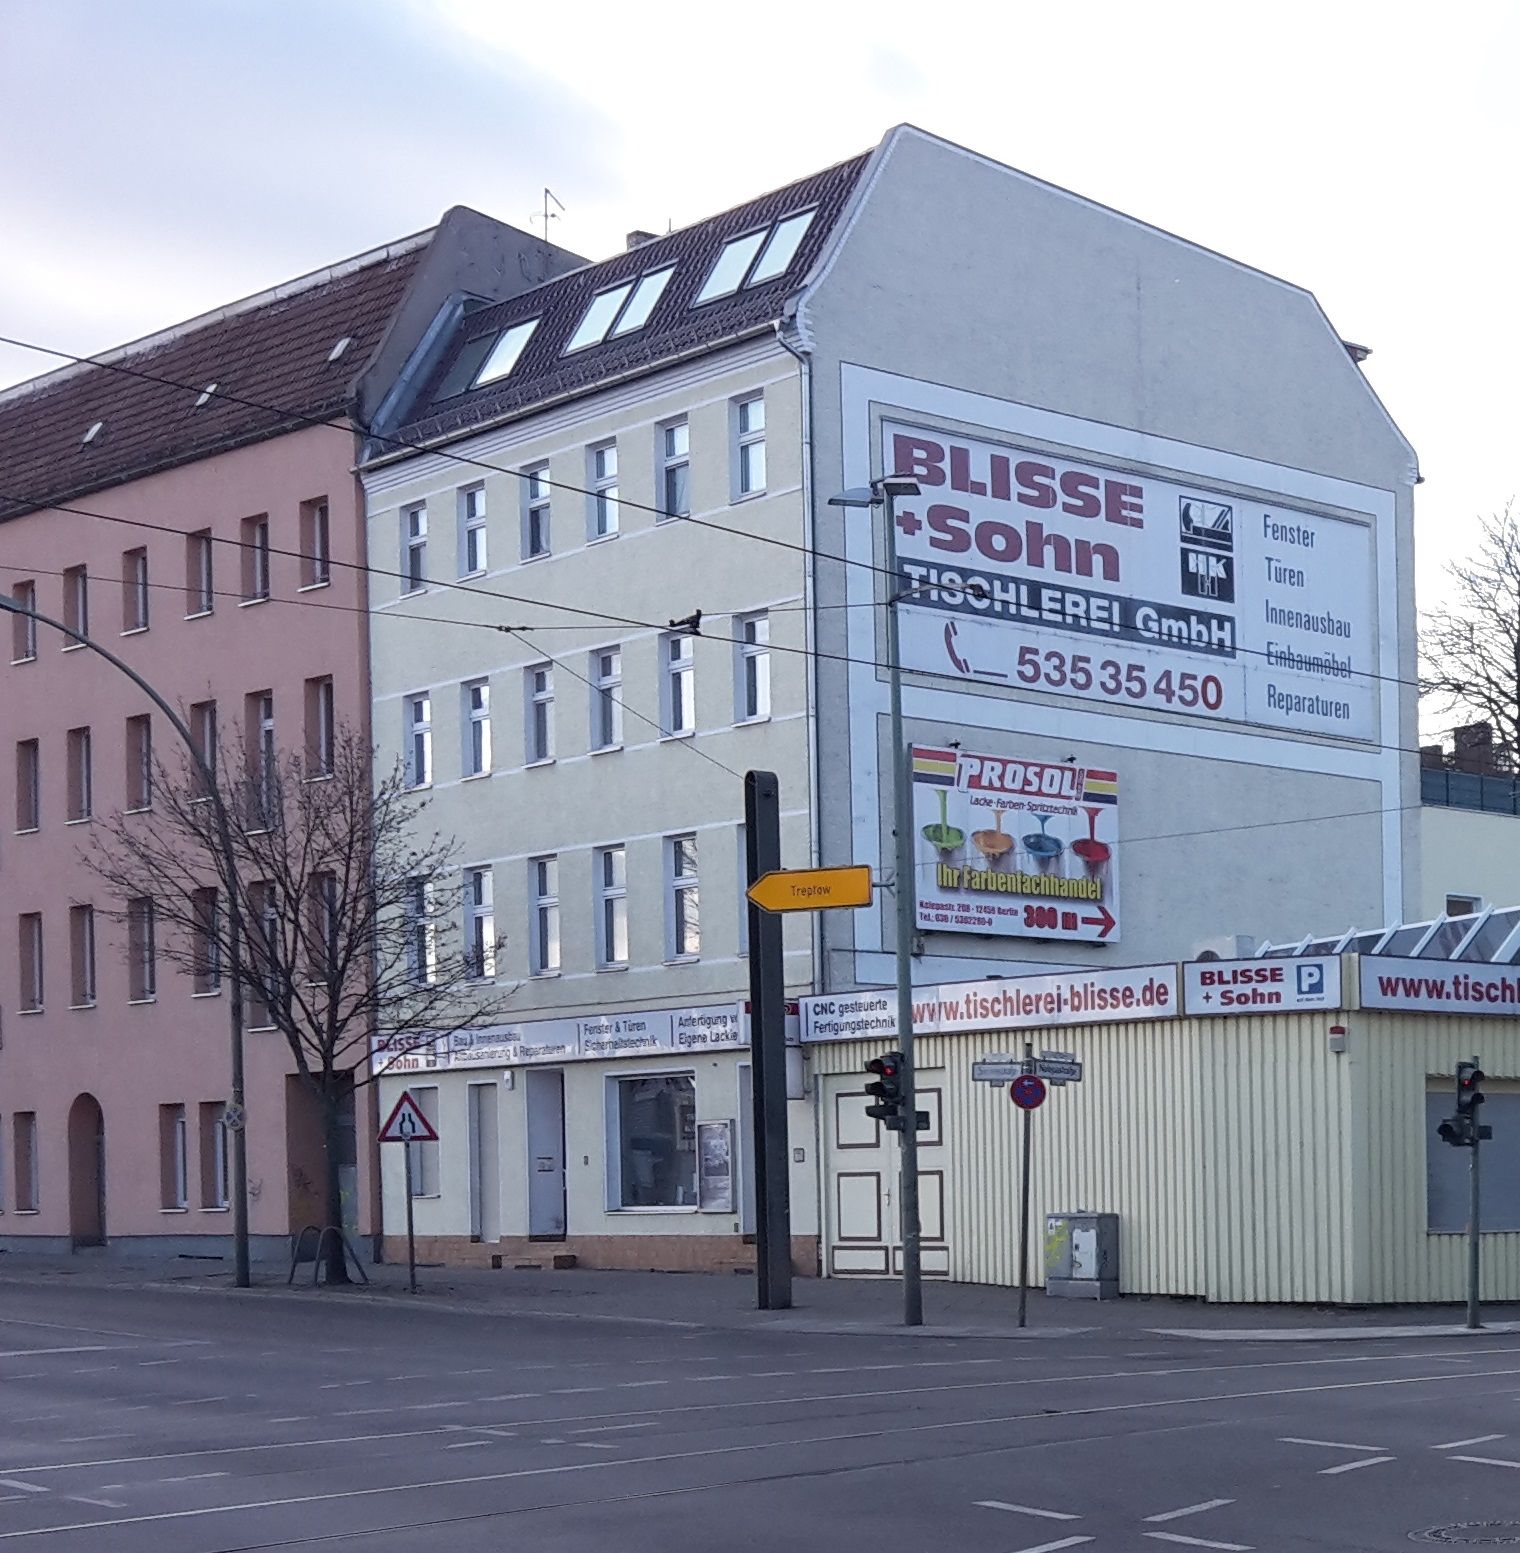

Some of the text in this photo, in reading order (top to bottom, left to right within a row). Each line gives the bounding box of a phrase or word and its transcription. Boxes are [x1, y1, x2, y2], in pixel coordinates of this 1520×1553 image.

[893, 432, 1145, 529] BLISSE
[1262, 513, 1315, 549] Fenster
[1264, 557, 1305, 588] Türen
[902, 563, 1233, 652] TISCHLEREI GmbH
[1264, 600, 1352, 640] Innenausbau
[1266, 641, 1353, 679] Einbaumöbel
[1266, 683, 1351, 720] Reparaturen
[957, 757, 1077, 796] PROSOL
[790, 884, 832, 898] Treptow
[937, 863, 1102, 900] Ihr Farbenfachhandel
[1200, 967, 1284, 986] BLISSE
[813, 999, 888, 1017] CNC gesteuerte
[912, 977, 1169, 1024] www.tischlerei-blisse.de
[1220, 988, 1282, 1006] Sohn
[584, 1022, 612, 1035] Fenster
[678, 1015, 728, 1031] Anfertigung
[679, 1029, 738, 1047] Eigene Lackie
[813, 1015, 896, 1036] Fertigungstechnik
[387, 1055, 420, 1070] Sohn
